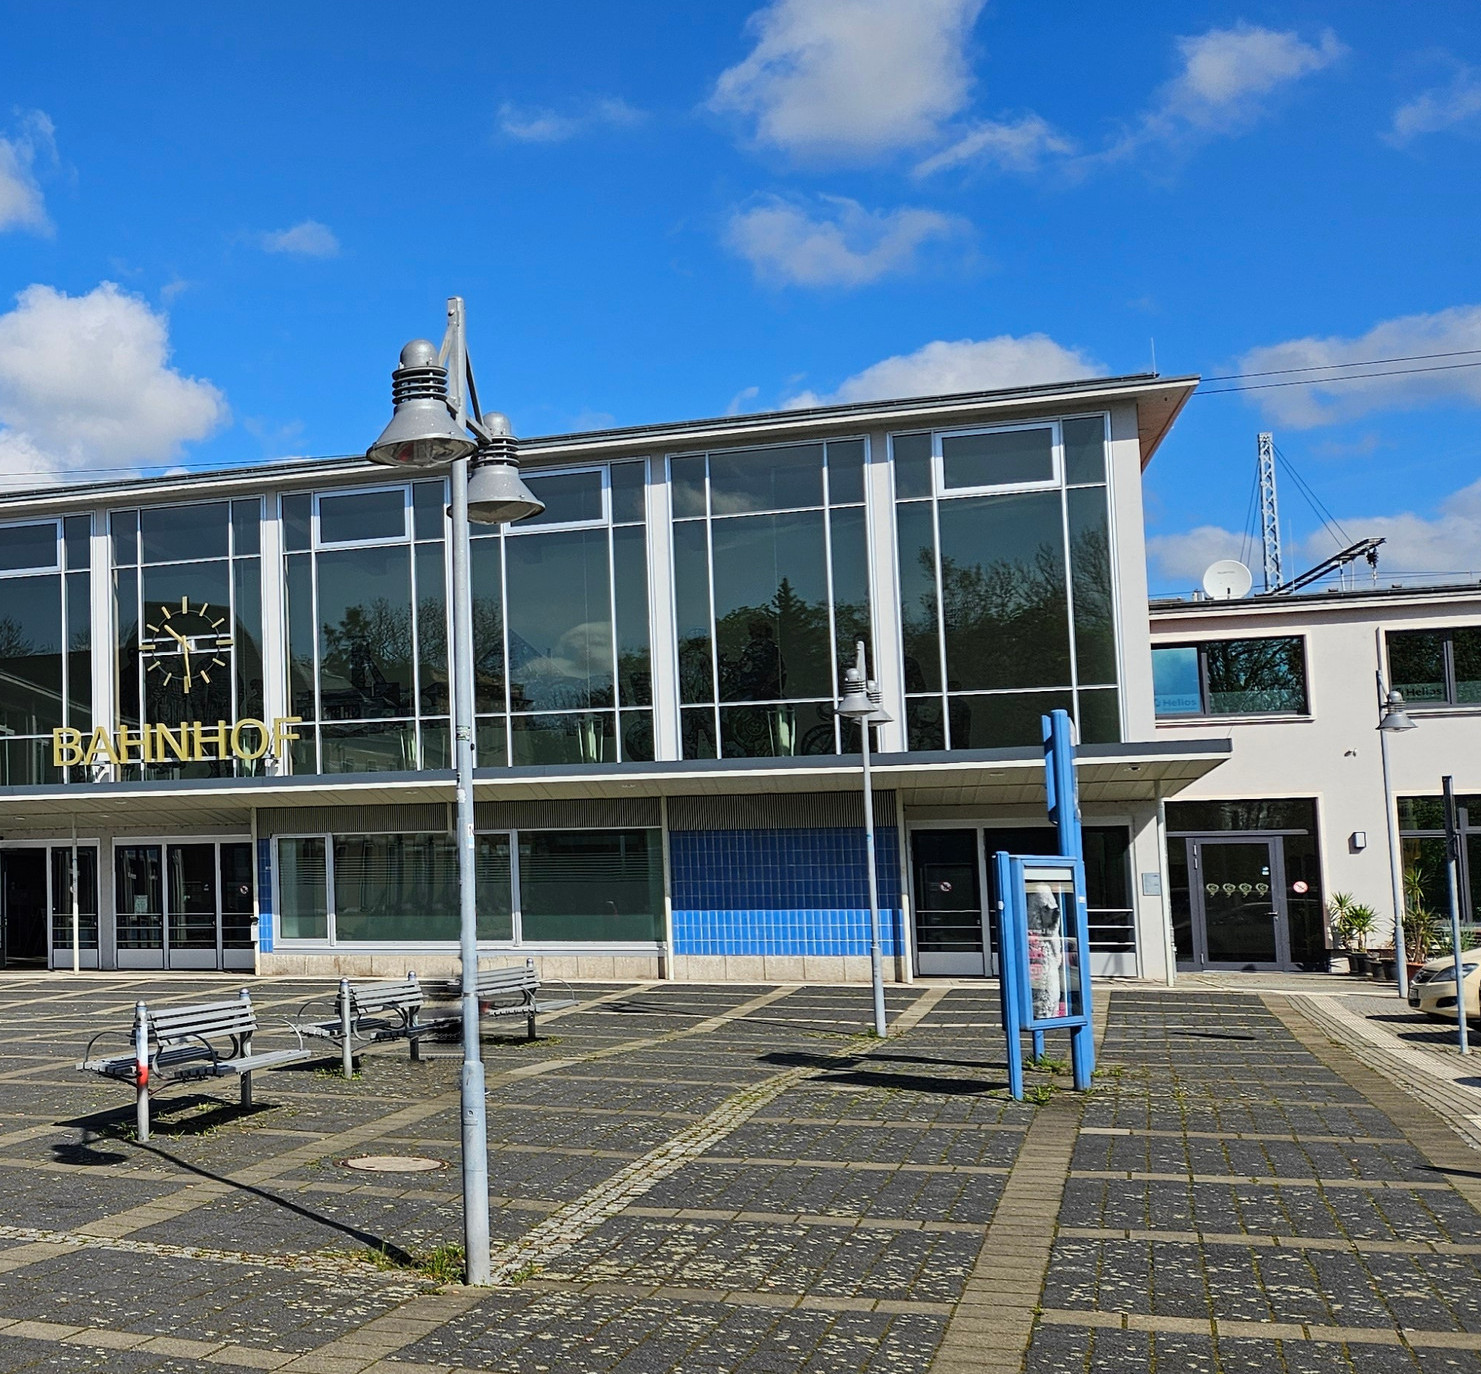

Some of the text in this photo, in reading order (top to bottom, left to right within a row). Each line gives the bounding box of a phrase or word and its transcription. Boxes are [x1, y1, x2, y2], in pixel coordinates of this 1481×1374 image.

[1406, 687, 1442, 696] Helios
[1163, 698, 1197, 706] Helios
[53, 717, 302, 766] BAHNHOF
